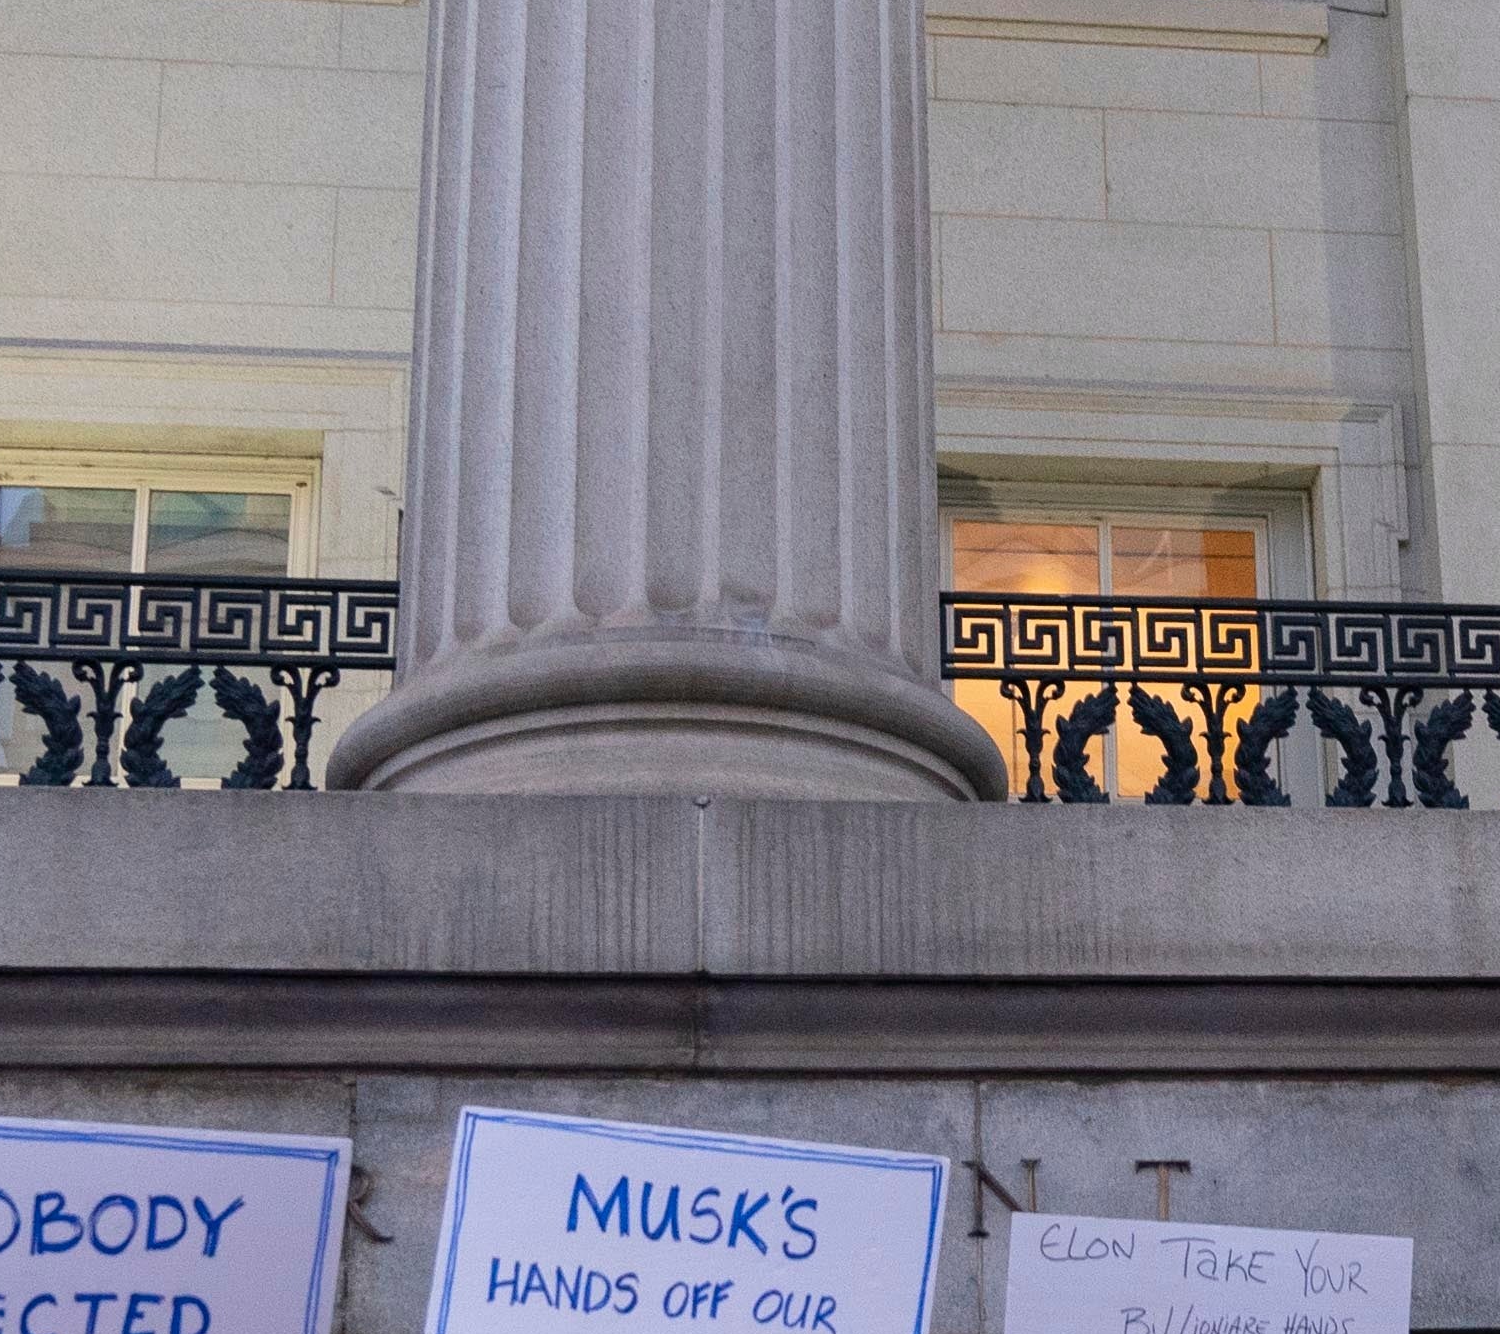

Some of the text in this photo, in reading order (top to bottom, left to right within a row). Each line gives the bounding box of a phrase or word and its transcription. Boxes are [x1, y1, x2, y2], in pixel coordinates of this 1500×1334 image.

[566, 1172, 819, 1260] MUSK'S
[486, 1256, 639, 1315] HANDS
[663, 1279, 735, 1321] OFF
[1039, 1222, 1136, 1263] ELON
[1294, 1238, 1370, 1299] YOUR
